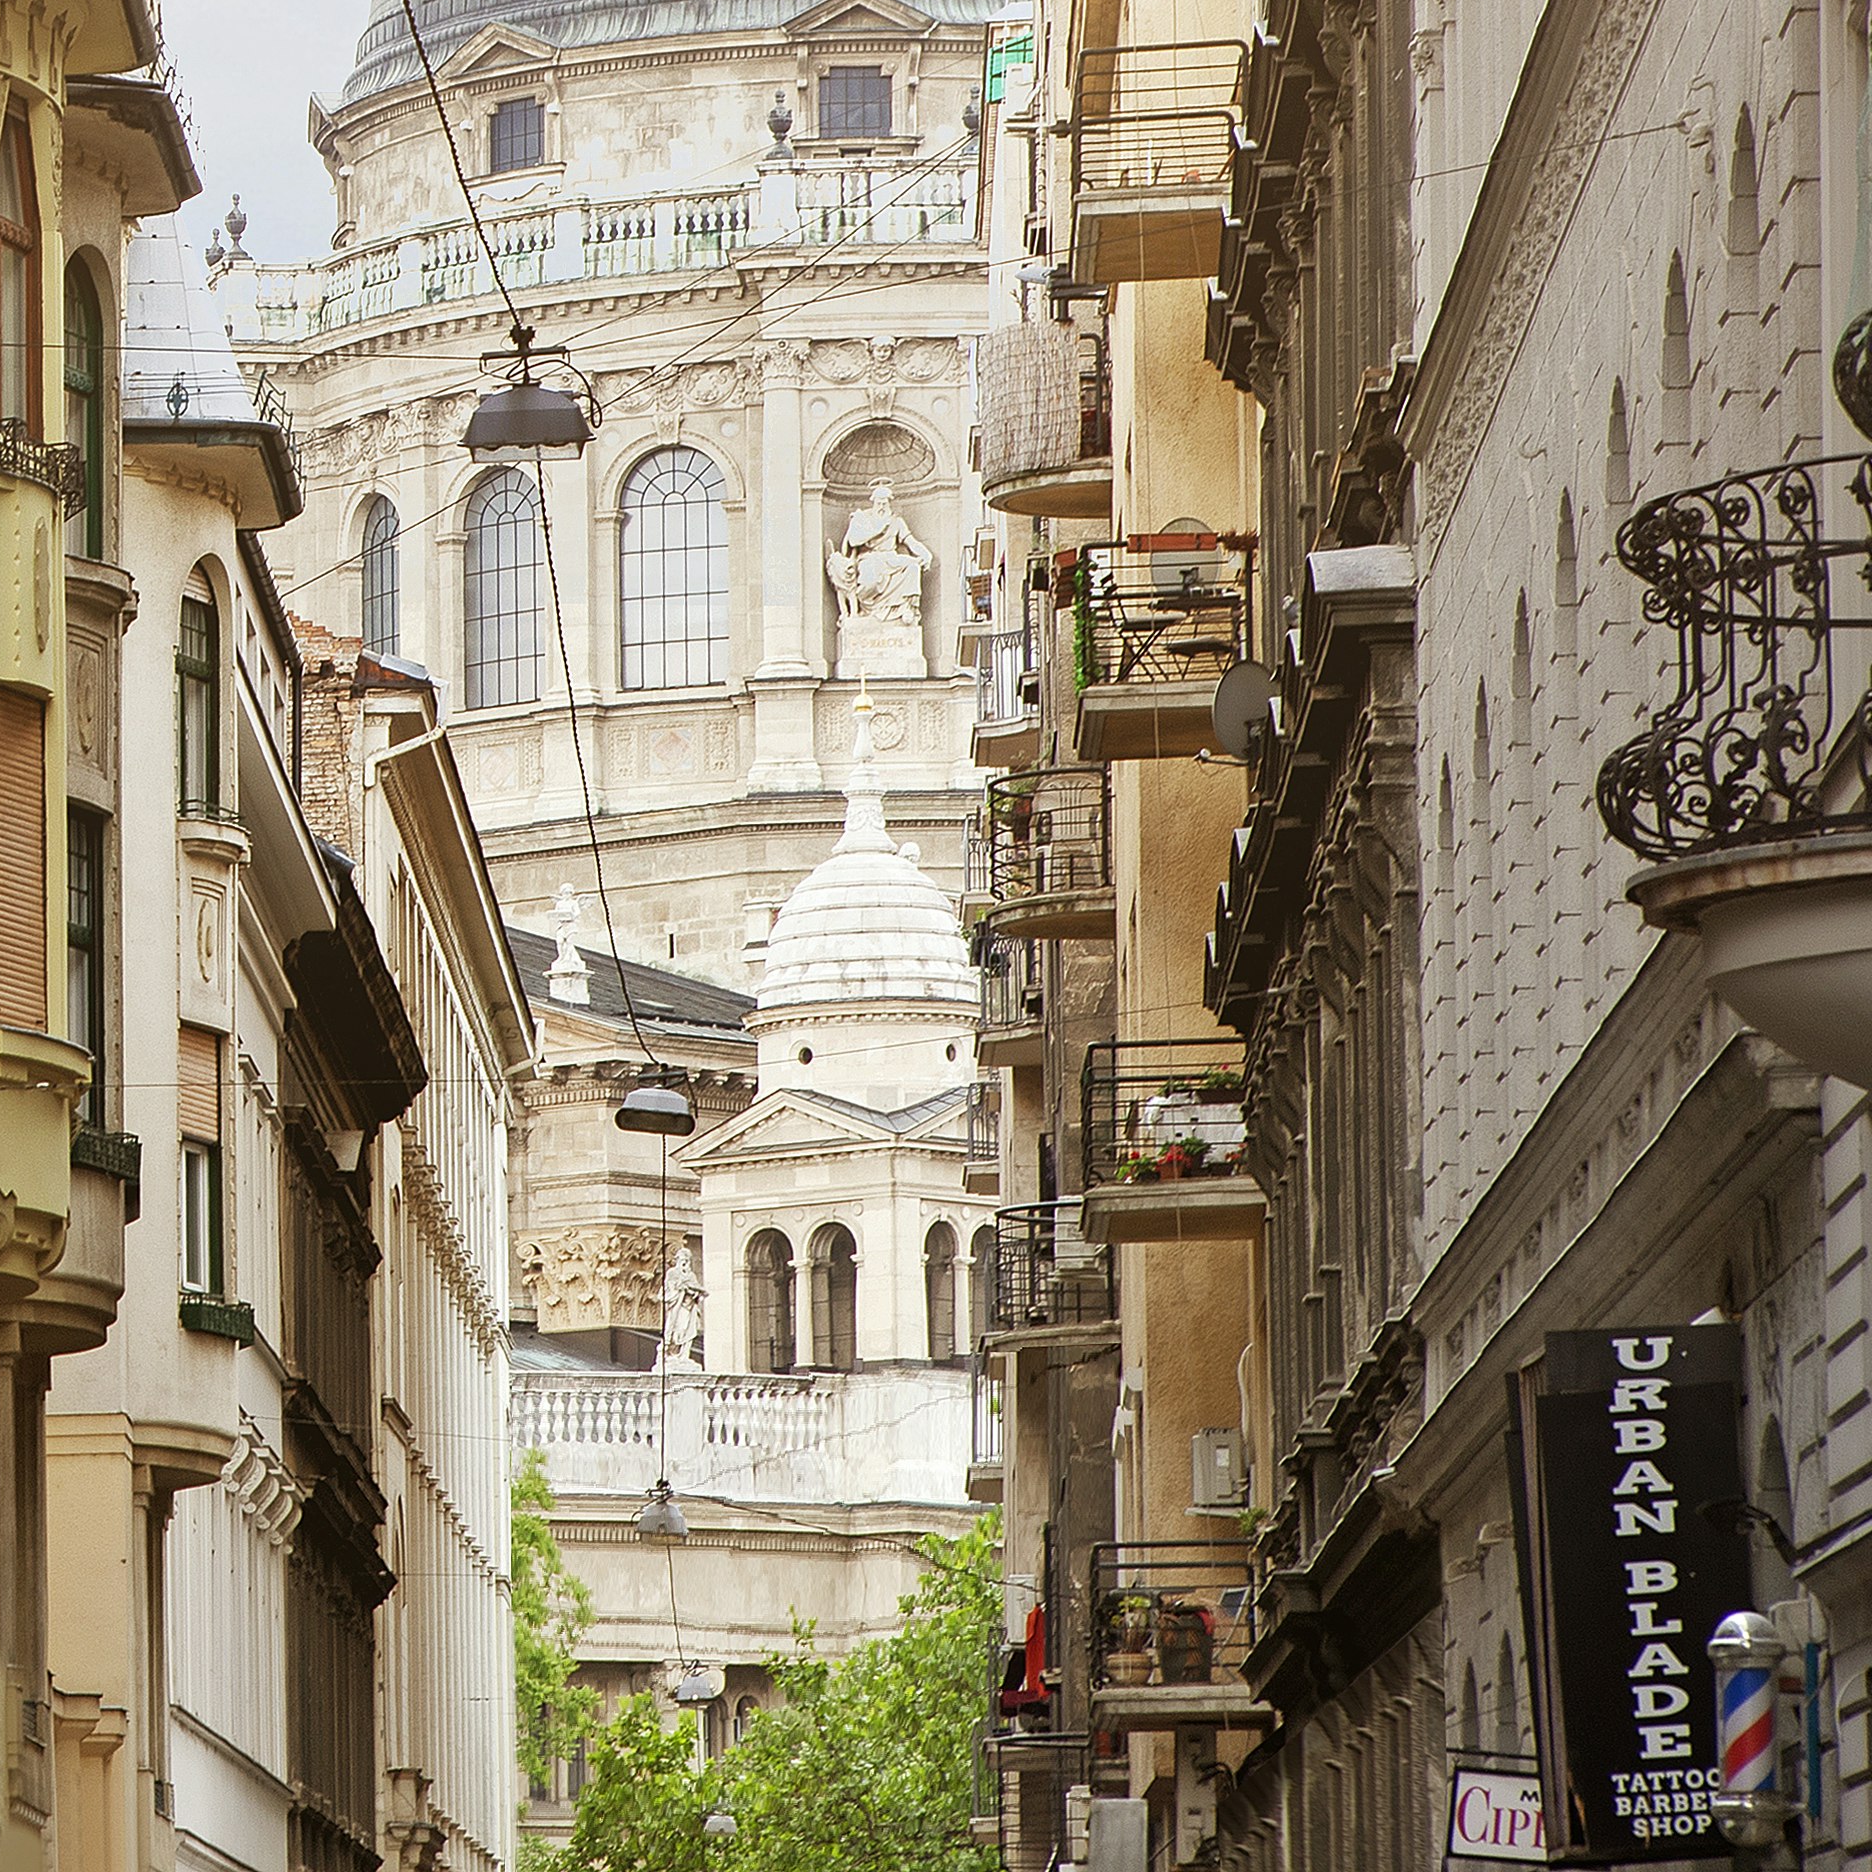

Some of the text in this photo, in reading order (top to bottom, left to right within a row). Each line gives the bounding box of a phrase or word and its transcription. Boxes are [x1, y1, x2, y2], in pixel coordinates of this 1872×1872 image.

[1608, 1336, 1693, 1760] URBAN BLADE
[1632, 1814, 1713, 1839] SHOP
